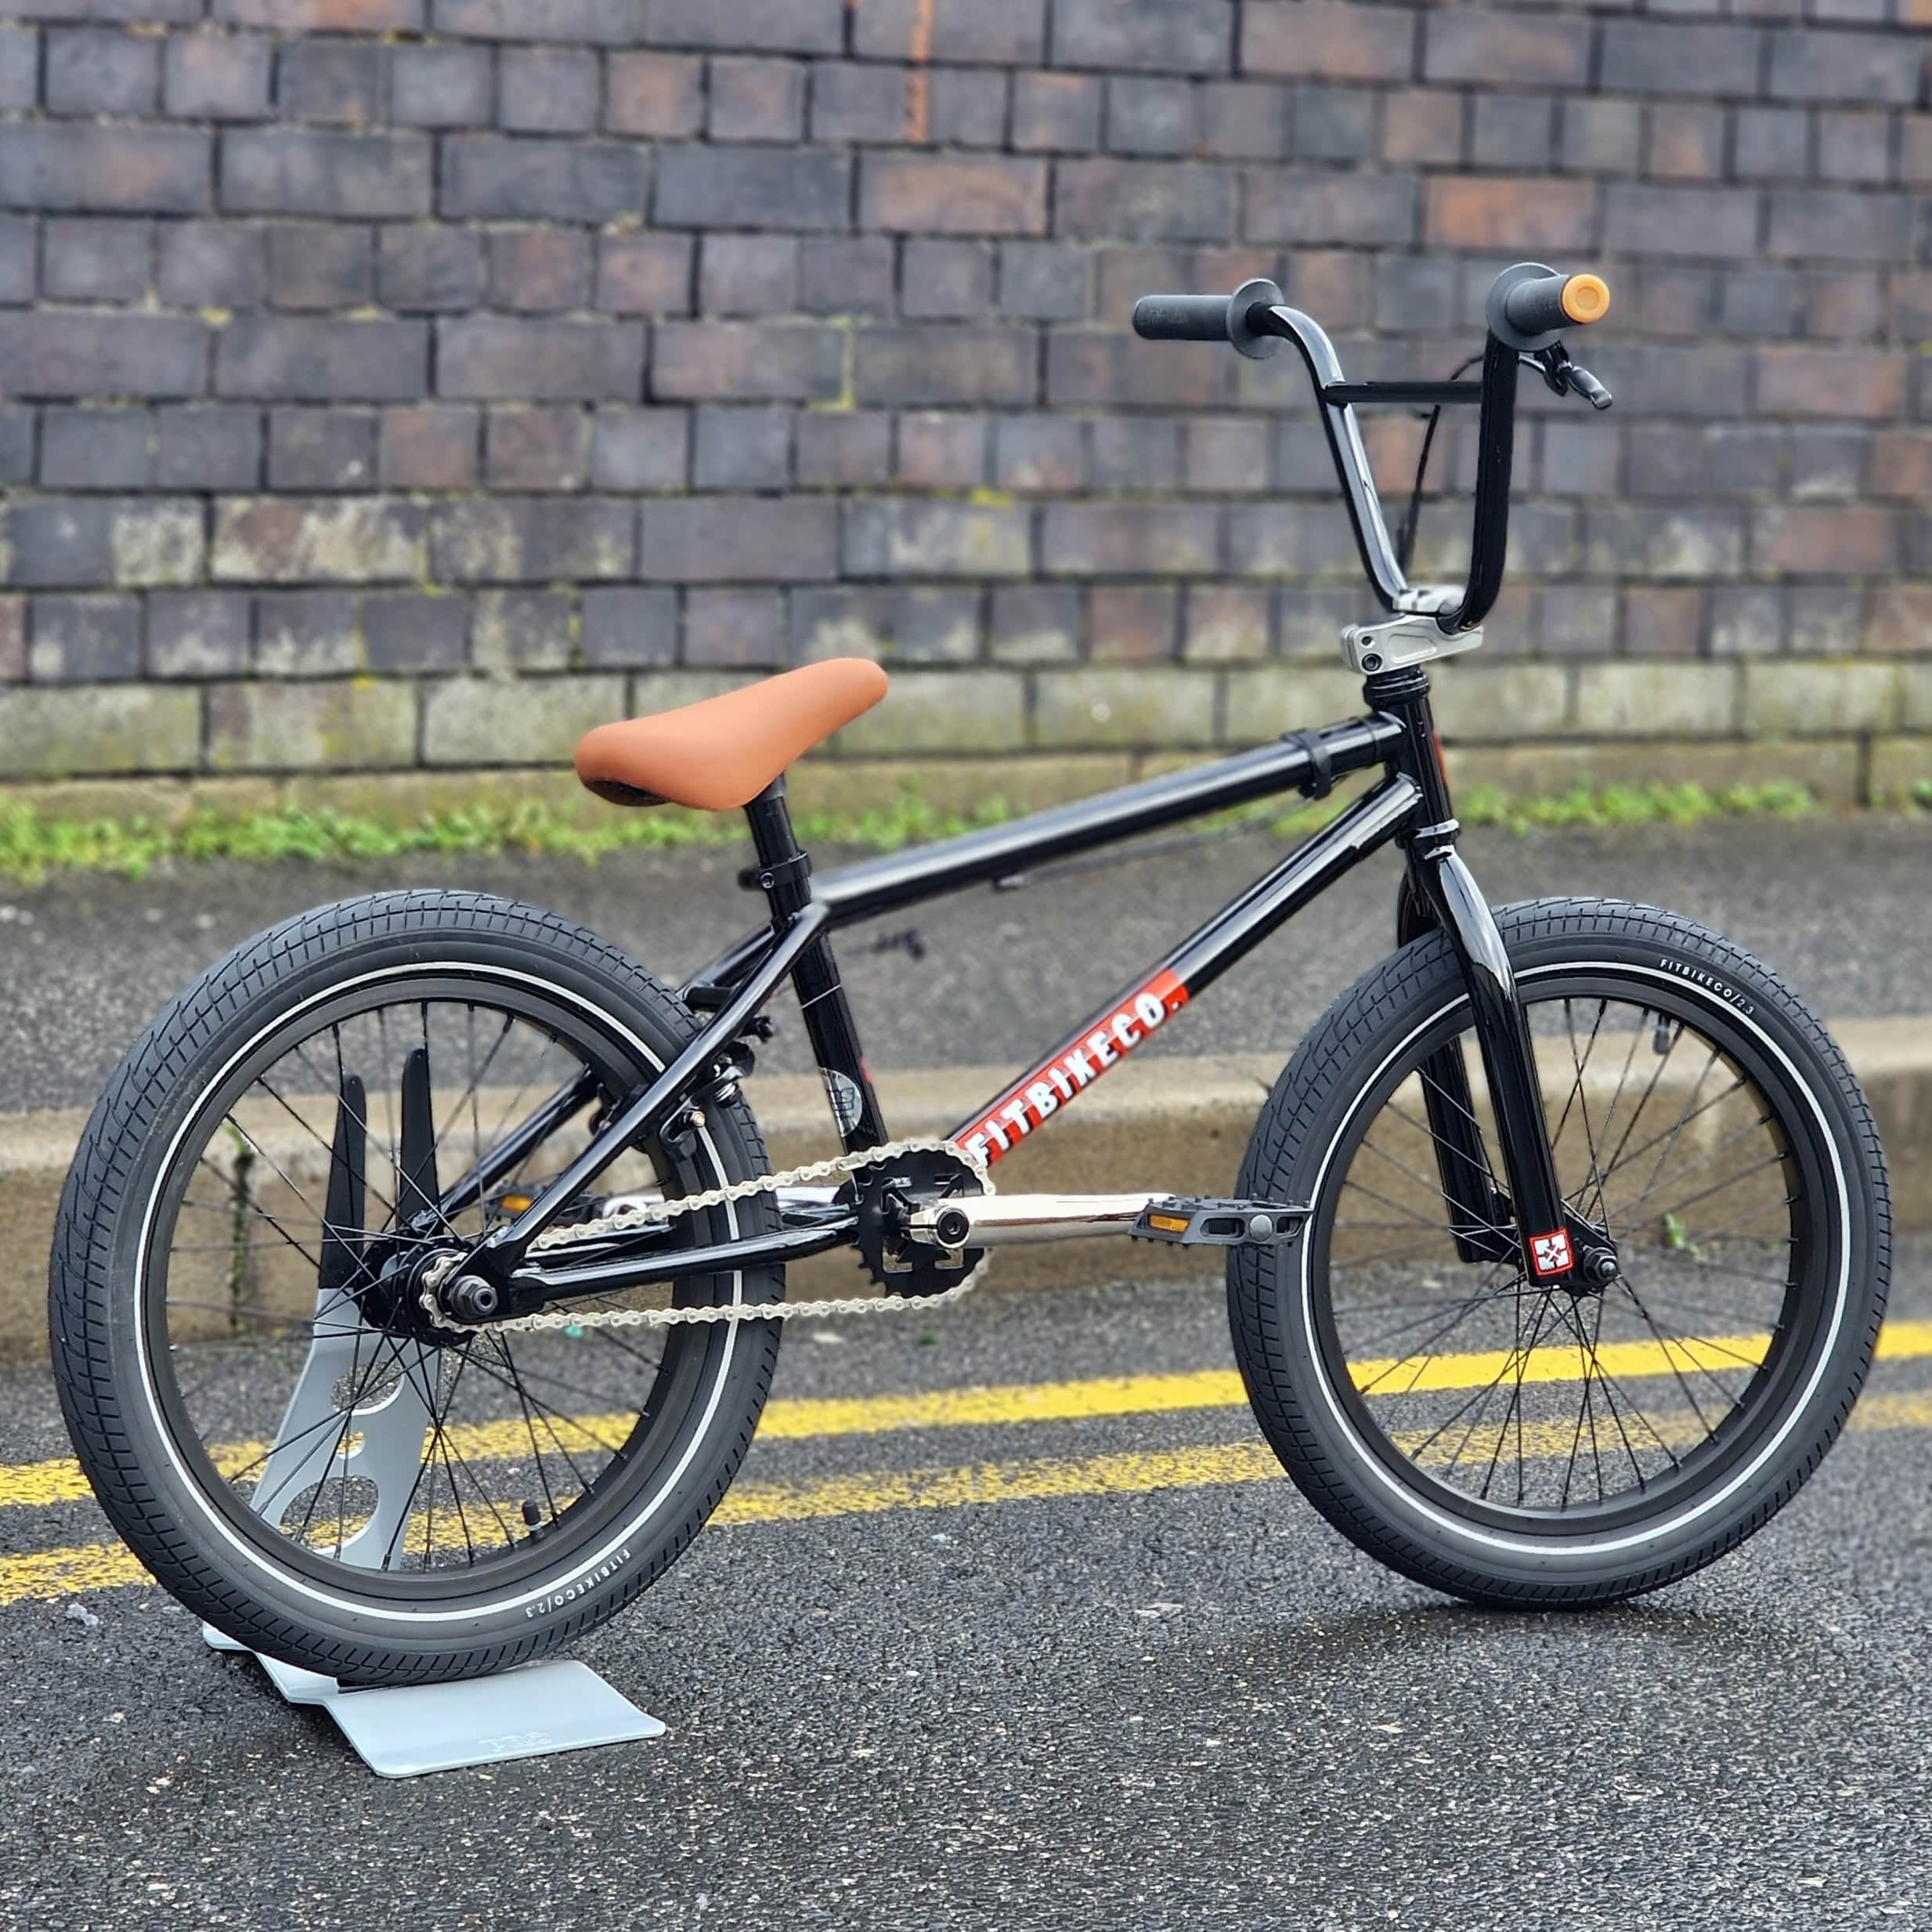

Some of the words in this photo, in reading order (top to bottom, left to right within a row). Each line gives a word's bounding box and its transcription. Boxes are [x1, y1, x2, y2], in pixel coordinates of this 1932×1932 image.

[1659, 959, 1754, 1015] FITBIKECO/2.3
[965, 992, 1179, 1167] FITBIKECO.
[525, 1548, 631, 1618] FITBIKECO/2.3
